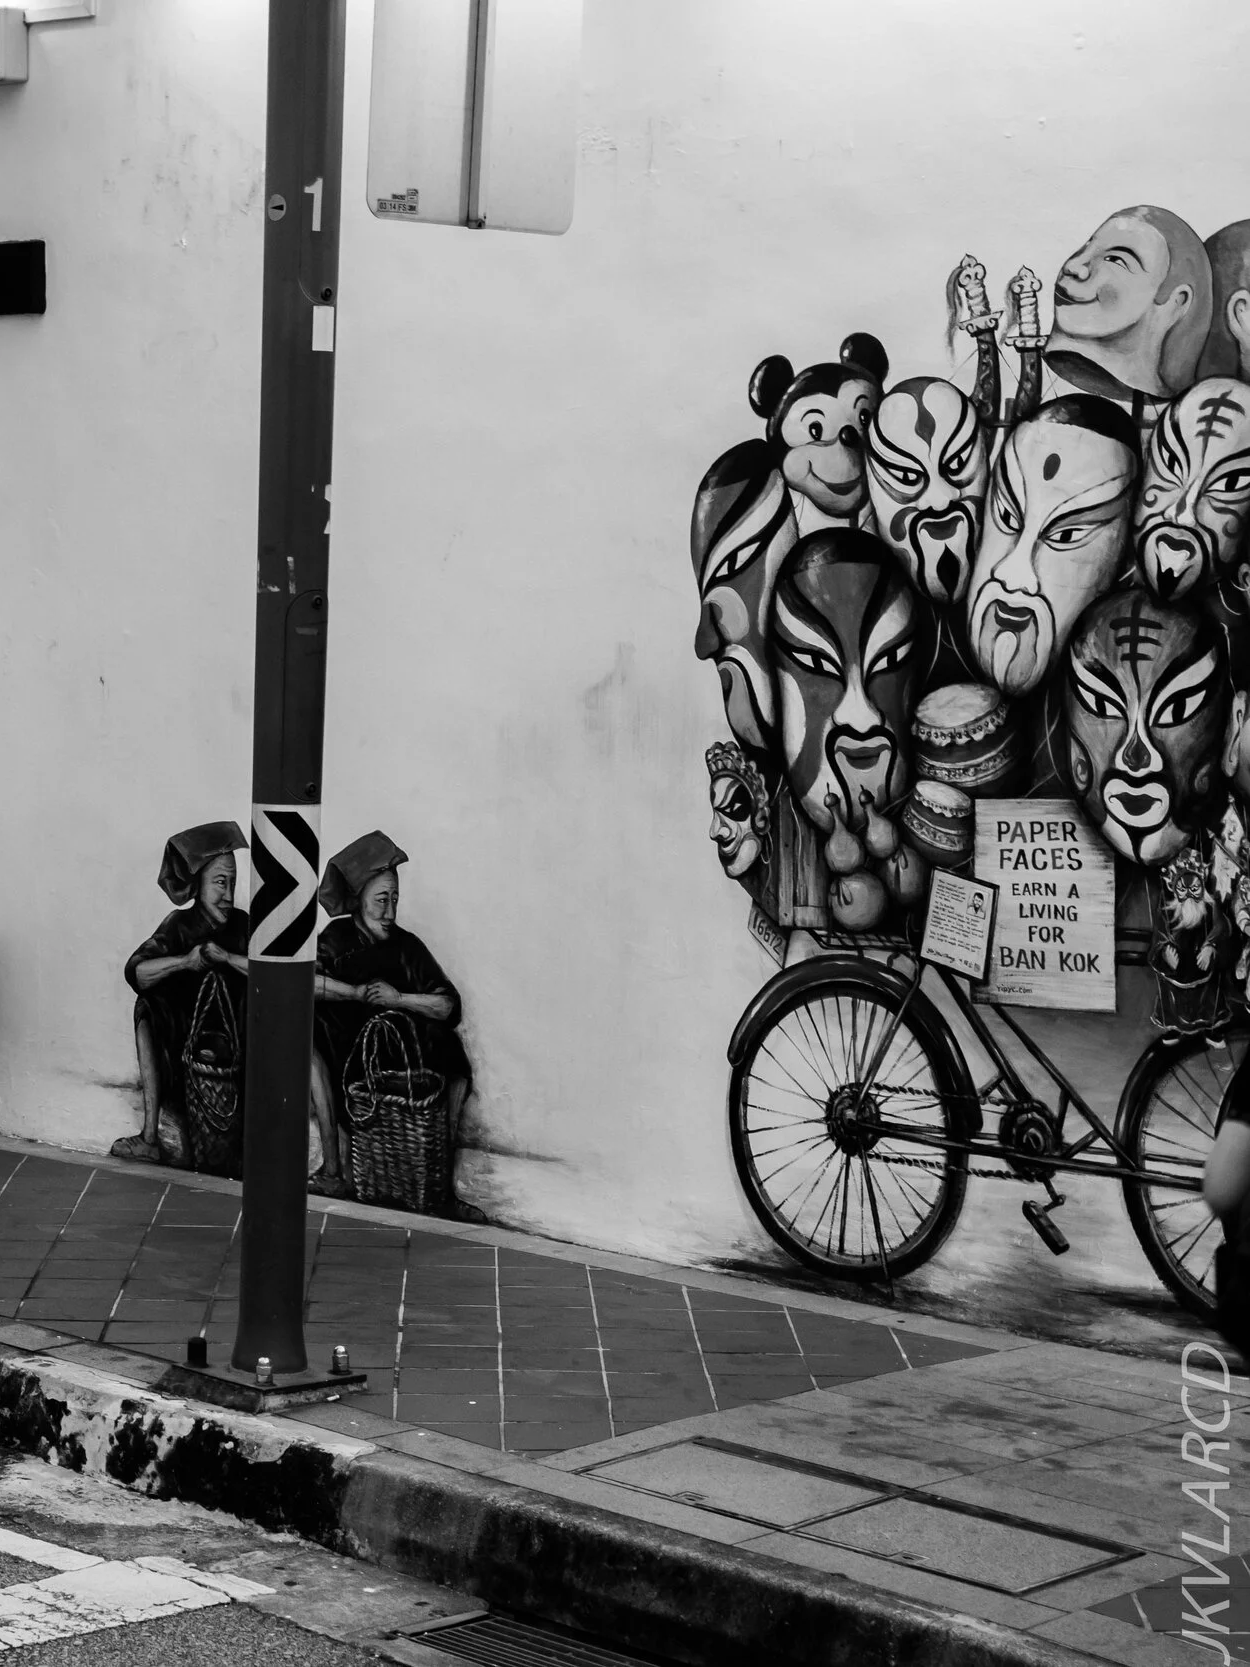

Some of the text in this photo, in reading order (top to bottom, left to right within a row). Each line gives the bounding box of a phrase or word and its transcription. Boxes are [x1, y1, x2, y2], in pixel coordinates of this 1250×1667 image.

[304, 177, 323, 231] 1
[996, 820, 1079, 843] PAPER
[999, 847, 1083, 871] FACES
[1012, 882, 1080, 899] EARN A
[1019, 903, 1079, 922] LIVING
[753, 910, 783, 956] 16672
[1028, 925, 1065, 944] FOR
[999, 946, 1046, 970] BAN
[1059, 950, 1101, 974] KOK
